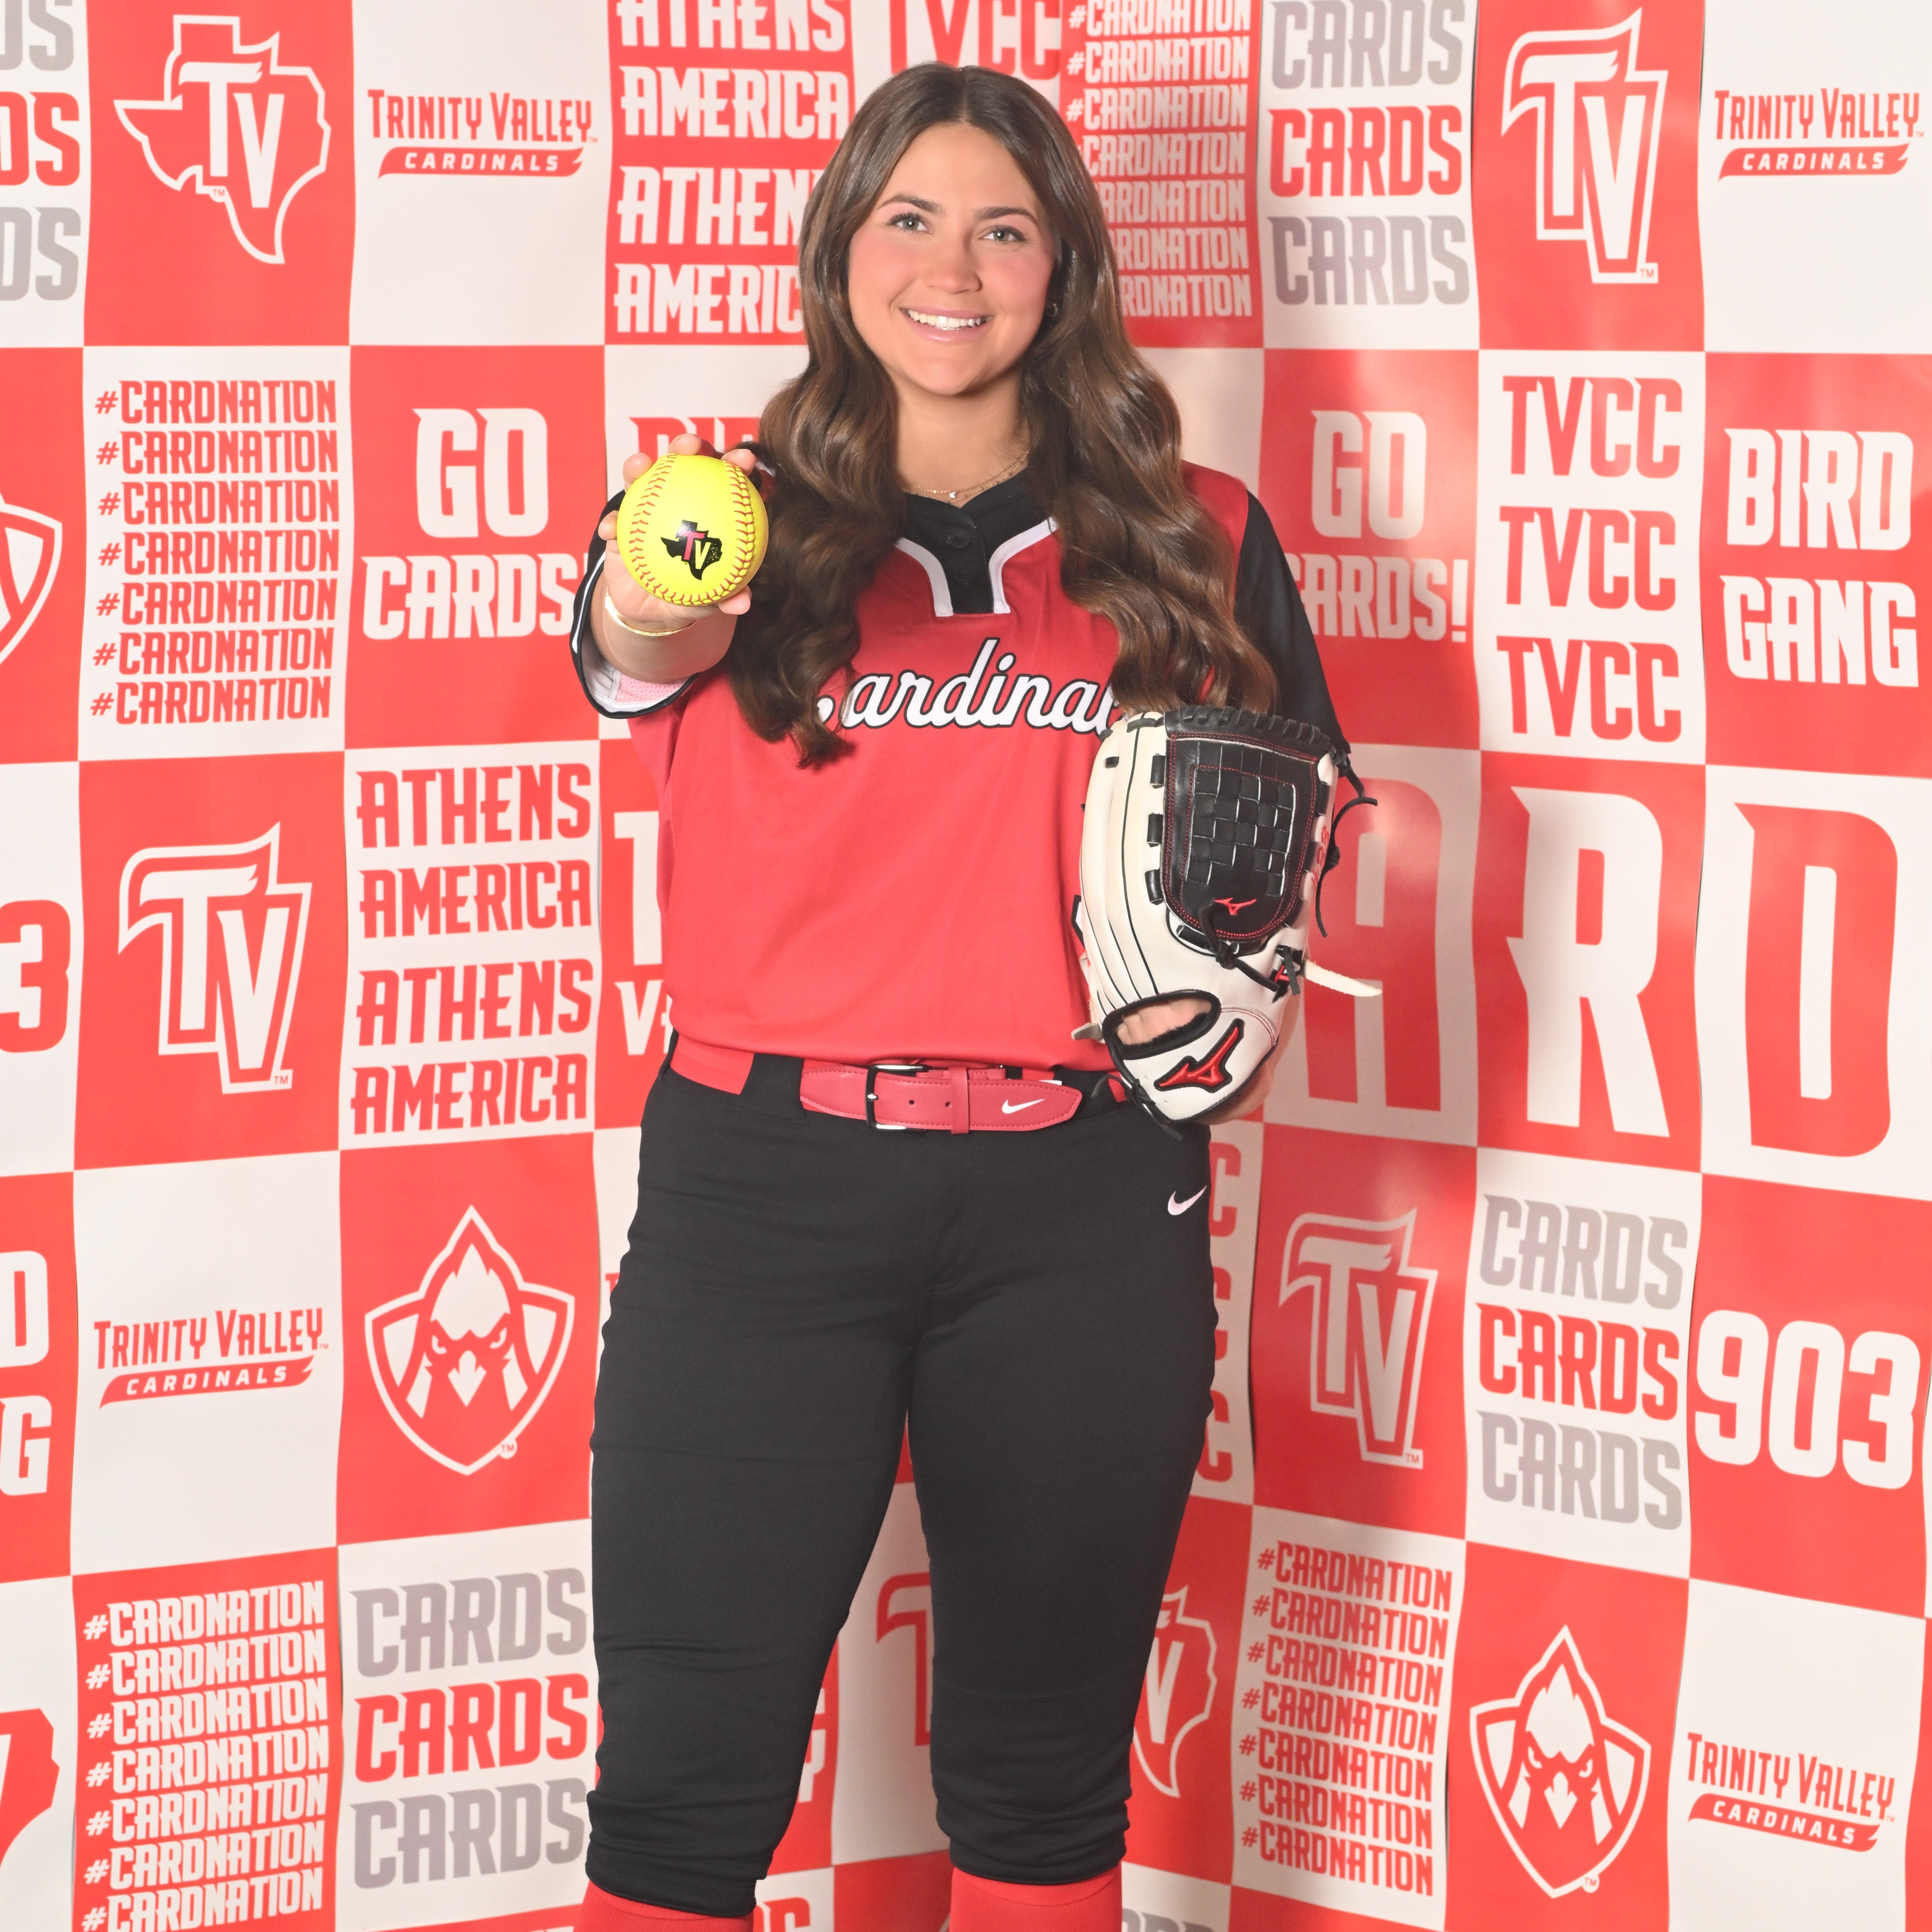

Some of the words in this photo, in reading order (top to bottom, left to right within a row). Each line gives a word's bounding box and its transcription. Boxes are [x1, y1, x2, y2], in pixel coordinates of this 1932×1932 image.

[617, 0, 845, 51] ATHENS
[1069, 0, 1251, 36] #CARDNATION
[1271, 0, 1465, 89] CARDS
[1067, 36, 1249, 83] #CARDNATION
[179, 62, 285, 208] TV
[368, 89, 481, 140] TRINITY
[490, 93, 591, 142] VALLEY
[619, 66, 848, 139] AMERICA
[1066, 84, 1247, 129] #CARDNATION
[1715, 90, 1813, 139] TRINITY
[1821, 88, 1919, 138] VALLEY
[405, 153, 557, 171] CARDINALS
[1077, 132, 1245, 176] CARDNATION
[1269, 105, 1461, 197] CARDS
[1521, 50, 1646, 259] TV
[1743, 152, 1884, 170] CARDINALS
[617, 166, 823, 246] ATHEN
[1098, 179, 1245, 223] ARDNATION
[1108, 227, 1249, 271] RDNATION
[1267, 216, 1470, 305] CARDS
[1640, 269, 1654, 278] TM
[614, 263, 804, 333] AMERIC
[1119, 274, 1252, 317] RDNATION
[95, 381, 336, 424] #CARDNATION
[1503, 376, 1682, 478] TVCC
[97, 430, 338, 474] #CARDNATION
[413, 408, 548, 538] GO
[1312, 411, 1427, 539] GO
[98, 480, 339, 524] #CARDNATION
[1725, 429, 1913, 550] BIRD
[99, 529, 339, 575] #CARDNATION
[677, 531, 711, 569] TV
[1500, 506, 1675, 611] TVCC
[96, 578, 337, 625] #CARDNATION
[361, 553, 588, 640] CARDS
[1720, 576, 1918, 687] GANG
[93, 627, 334, 674] #CARDNATION
[91, 676, 331, 724] #CARDNATION
[817, 638, 1118, 737] ardina
[1497, 636, 1681, 742] TVCC
[356, 763, 591, 848] ATHENS
[360, 860, 591, 938] AMERICA
[140, 864, 289, 1069] TV
[356, 959, 593, 1046] ATHENS
[274, 1075, 288, 1084] TM
[351, 1054, 587, 1134] AMERICA
[1479, 1194, 1688, 1309] CARDS
[94, 1318, 207, 1369] TRINITY
[216, 1308, 322, 1357] VALLEY
[1298, 1237, 1415, 1441] TV
[1476, 1303, 1679, 1420] CARDS
[127, 1366, 286, 1395] CARDINALS
[1695, 1310, 1920, 1489] 903
[1406, 1453, 1419, 1463] TM
[1477, 1411, 1682, 1529] CARDS
[1258, 1541, 1452, 1611] #CARDNATION
[84, 1581, 324, 1646] #CARDNATION
[350, 1568, 586, 1677] CARDS
[1253, 1588, 1448, 1659] #CARDNATION
[86, 1629, 325, 1695] #CARDNATION
[1146, 1610, 1184, 1744] V
[1248, 1635, 1443, 1707] #CARDNATION
[87, 1677, 328, 1744] #CARDNATION
[356, 1674, 588, 1782] CARDS
[1243, 1681, 1437, 1754] #CARDNATION
[86, 1725, 328, 1793] #CARDNATION
[1240, 1728, 1432, 1802] #CARDNATION
[1688, 1732, 1790, 1798] TRINITY
[1799, 1754, 1894, 1820] VALLEY
[86, 1773, 328, 1841] #CARDNATION
[349, 1777, 587, 1889] CARDS
[1241, 1774, 1432, 1849] #CARDNATION
[1713, 1801, 1854, 1844] CARDINALS
[85, 1821, 324, 1889] #CARDNATION
[1243, 1820, 1432, 1896] #CARDNATION
[82, 1868, 322, 1932] #CARDNATION
